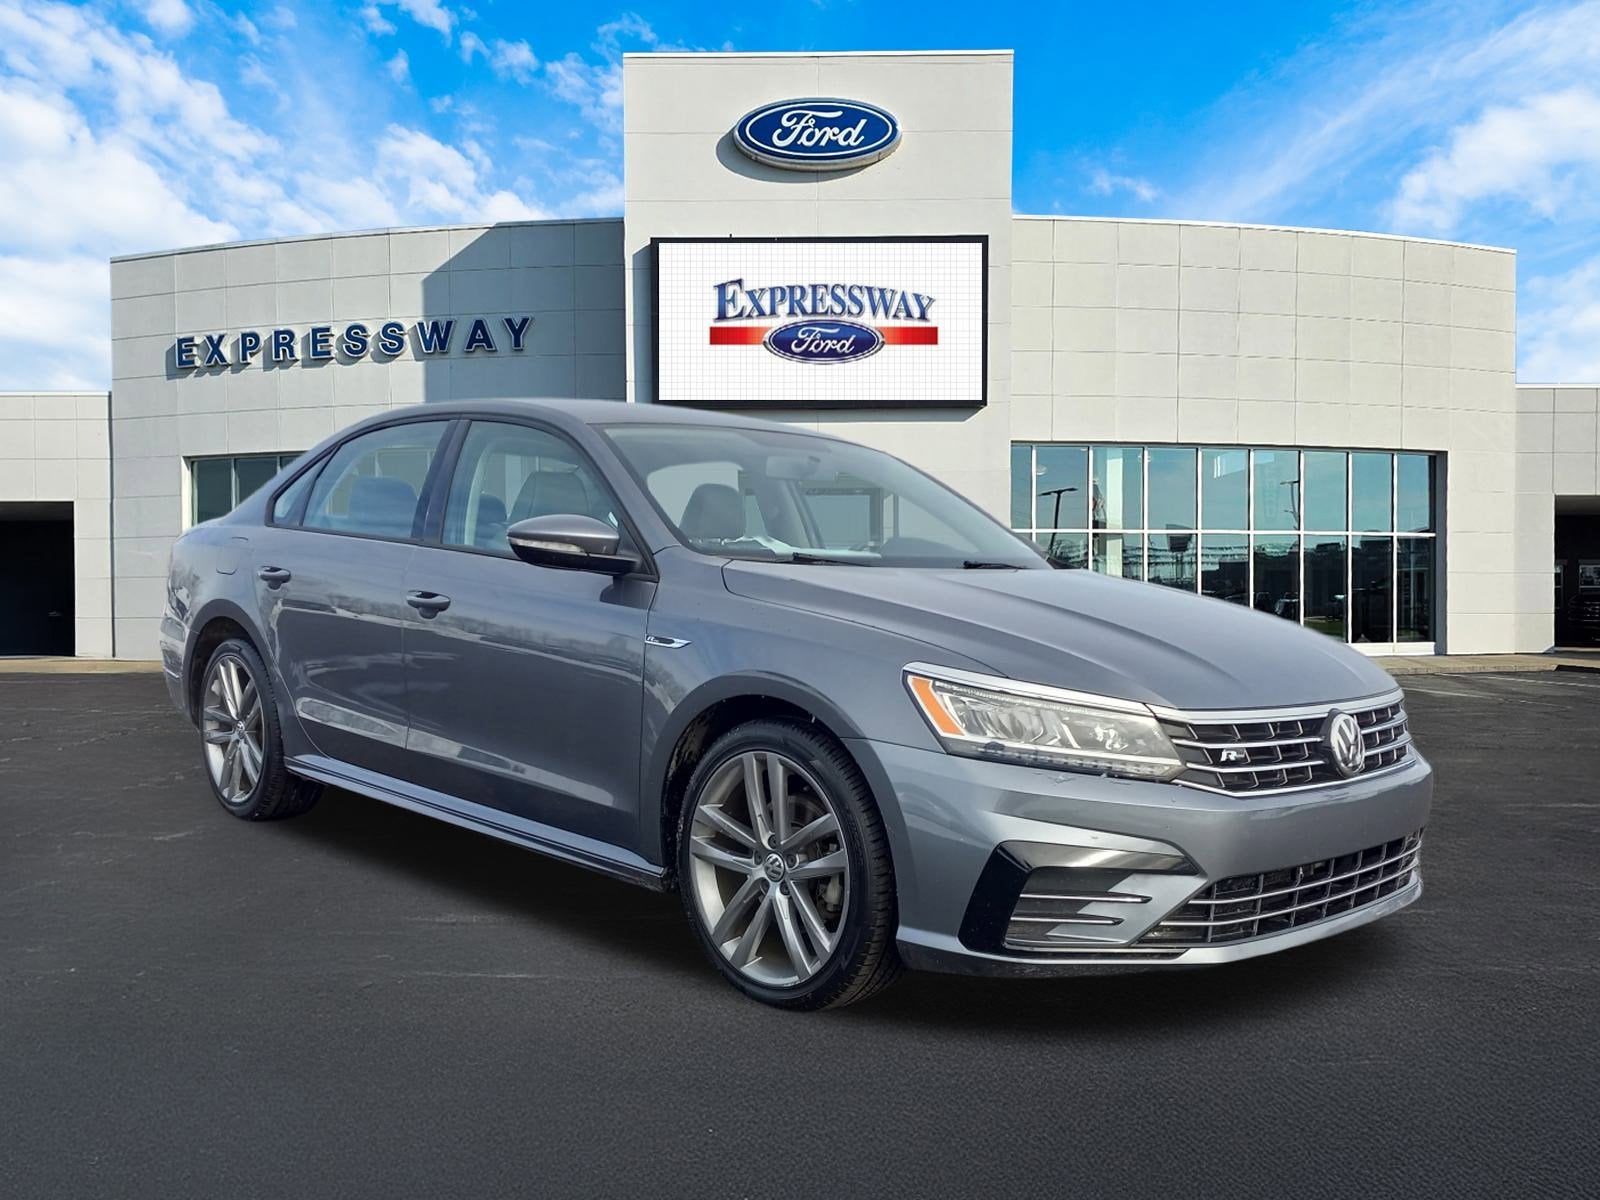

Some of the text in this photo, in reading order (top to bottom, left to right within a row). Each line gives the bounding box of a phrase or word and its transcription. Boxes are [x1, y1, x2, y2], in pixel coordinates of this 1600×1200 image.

[773, 110, 867, 148] Ford
[713, 278, 936, 322] EXPRESSWAY
[176, 315, 533, 368] EXPRESSWAY
[791, 326, 856, 353] Ford
